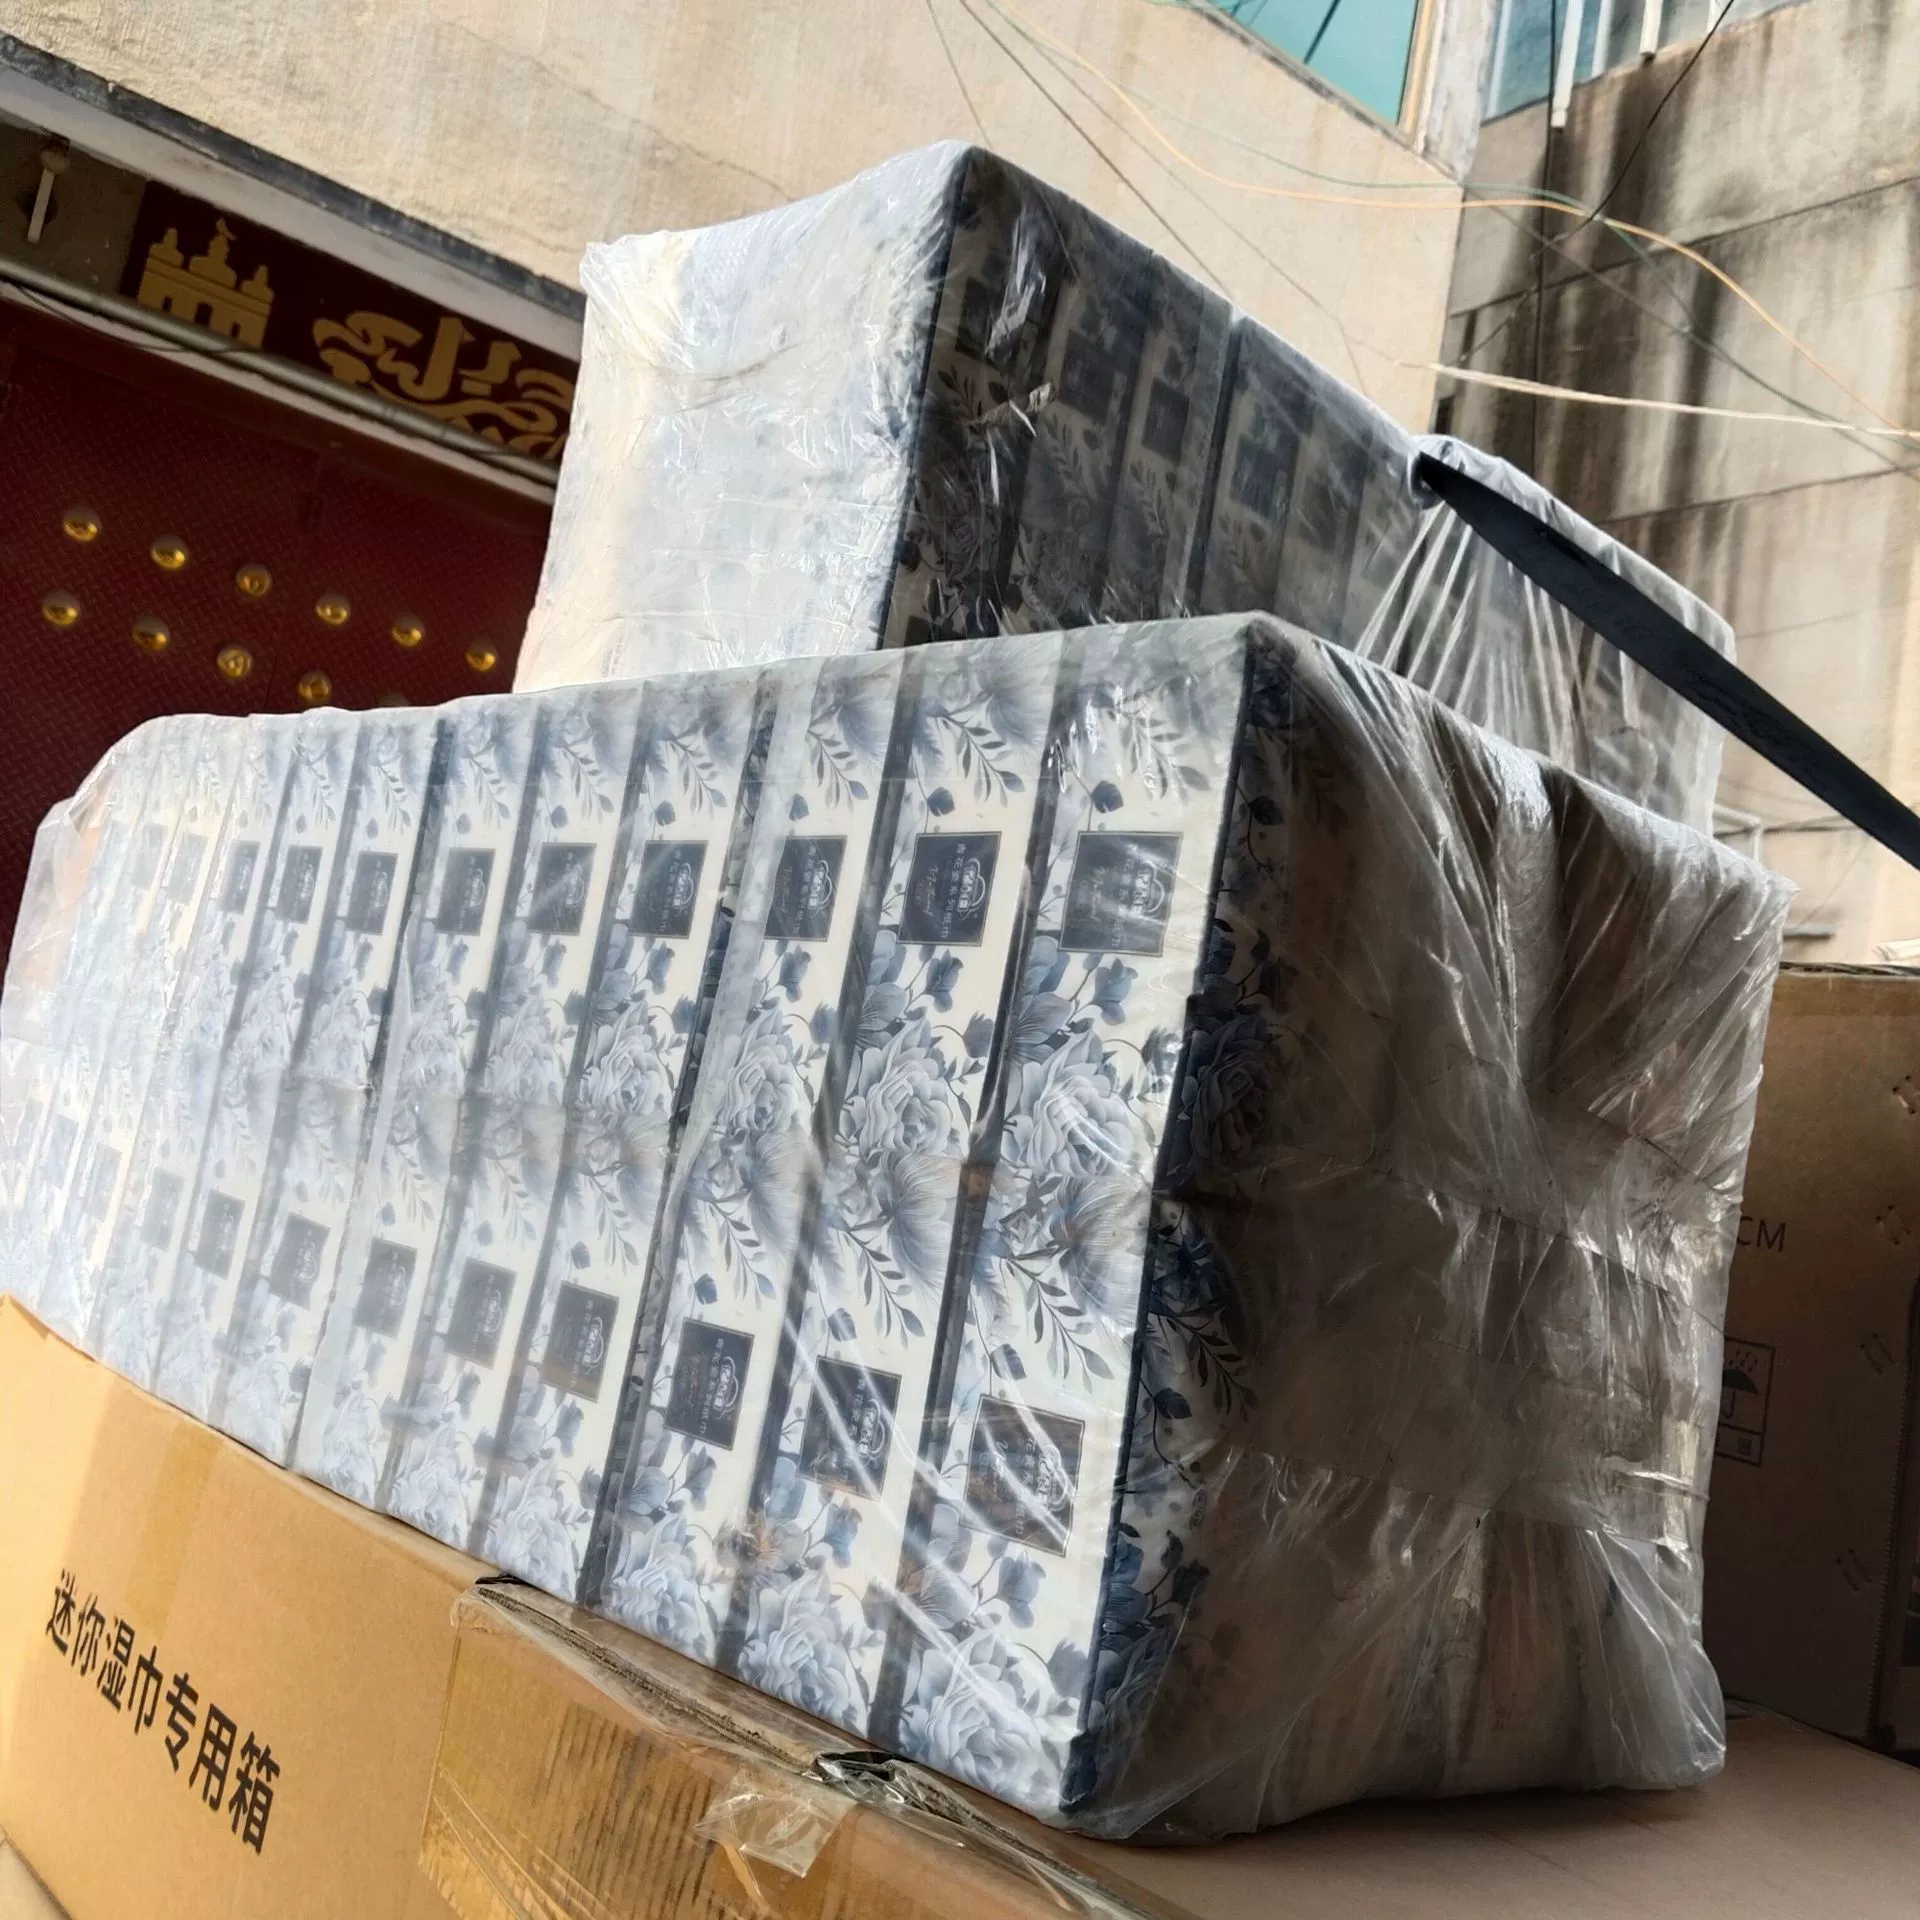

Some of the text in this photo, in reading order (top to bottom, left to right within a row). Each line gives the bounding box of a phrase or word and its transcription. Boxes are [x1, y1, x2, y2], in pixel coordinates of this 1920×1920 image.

[45, 1567, 281, 1856] 迷你湿巾专用箱
